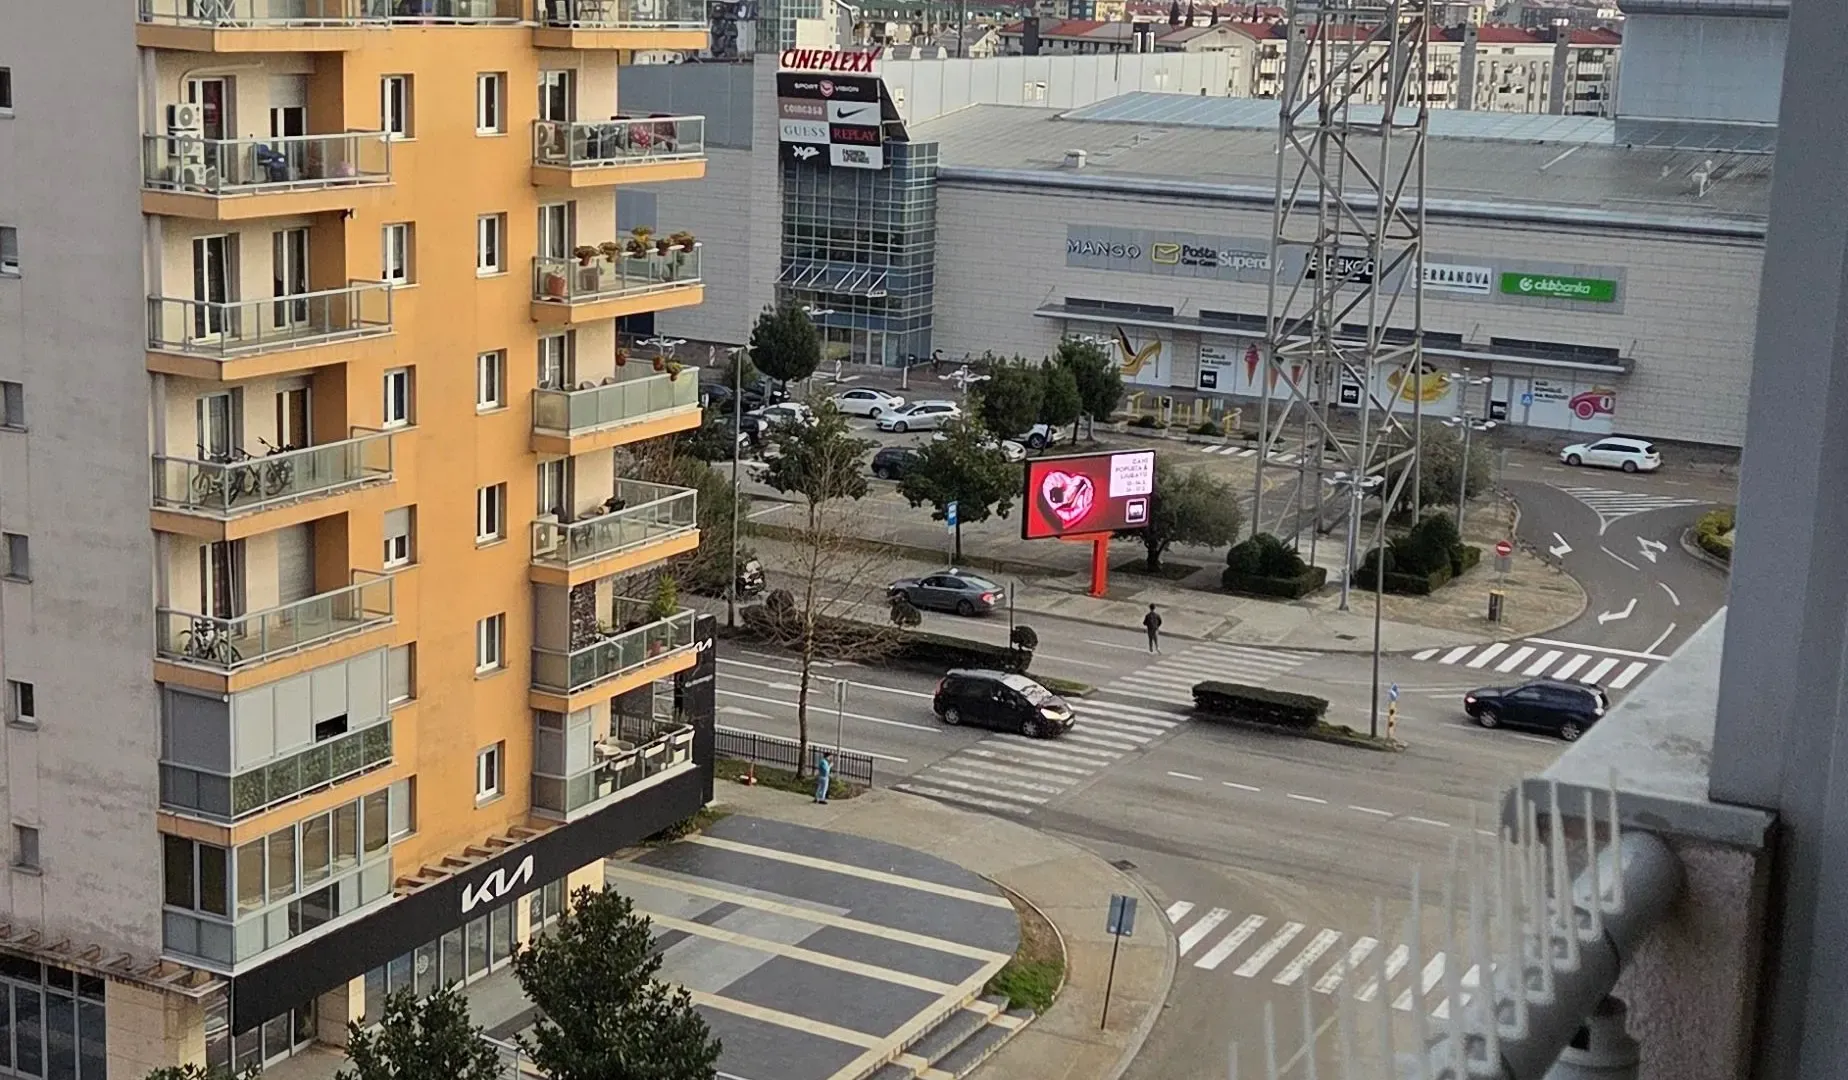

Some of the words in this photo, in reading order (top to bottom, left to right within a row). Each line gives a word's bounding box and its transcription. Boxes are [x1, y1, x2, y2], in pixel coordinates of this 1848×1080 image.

[781, 46, 881, 73] CINEPLEXX
[784, 126, 826, 138] GUESS
[833, 127, 877, 141] REPLAY
[1067, 238, 1141, 259] MANGO
